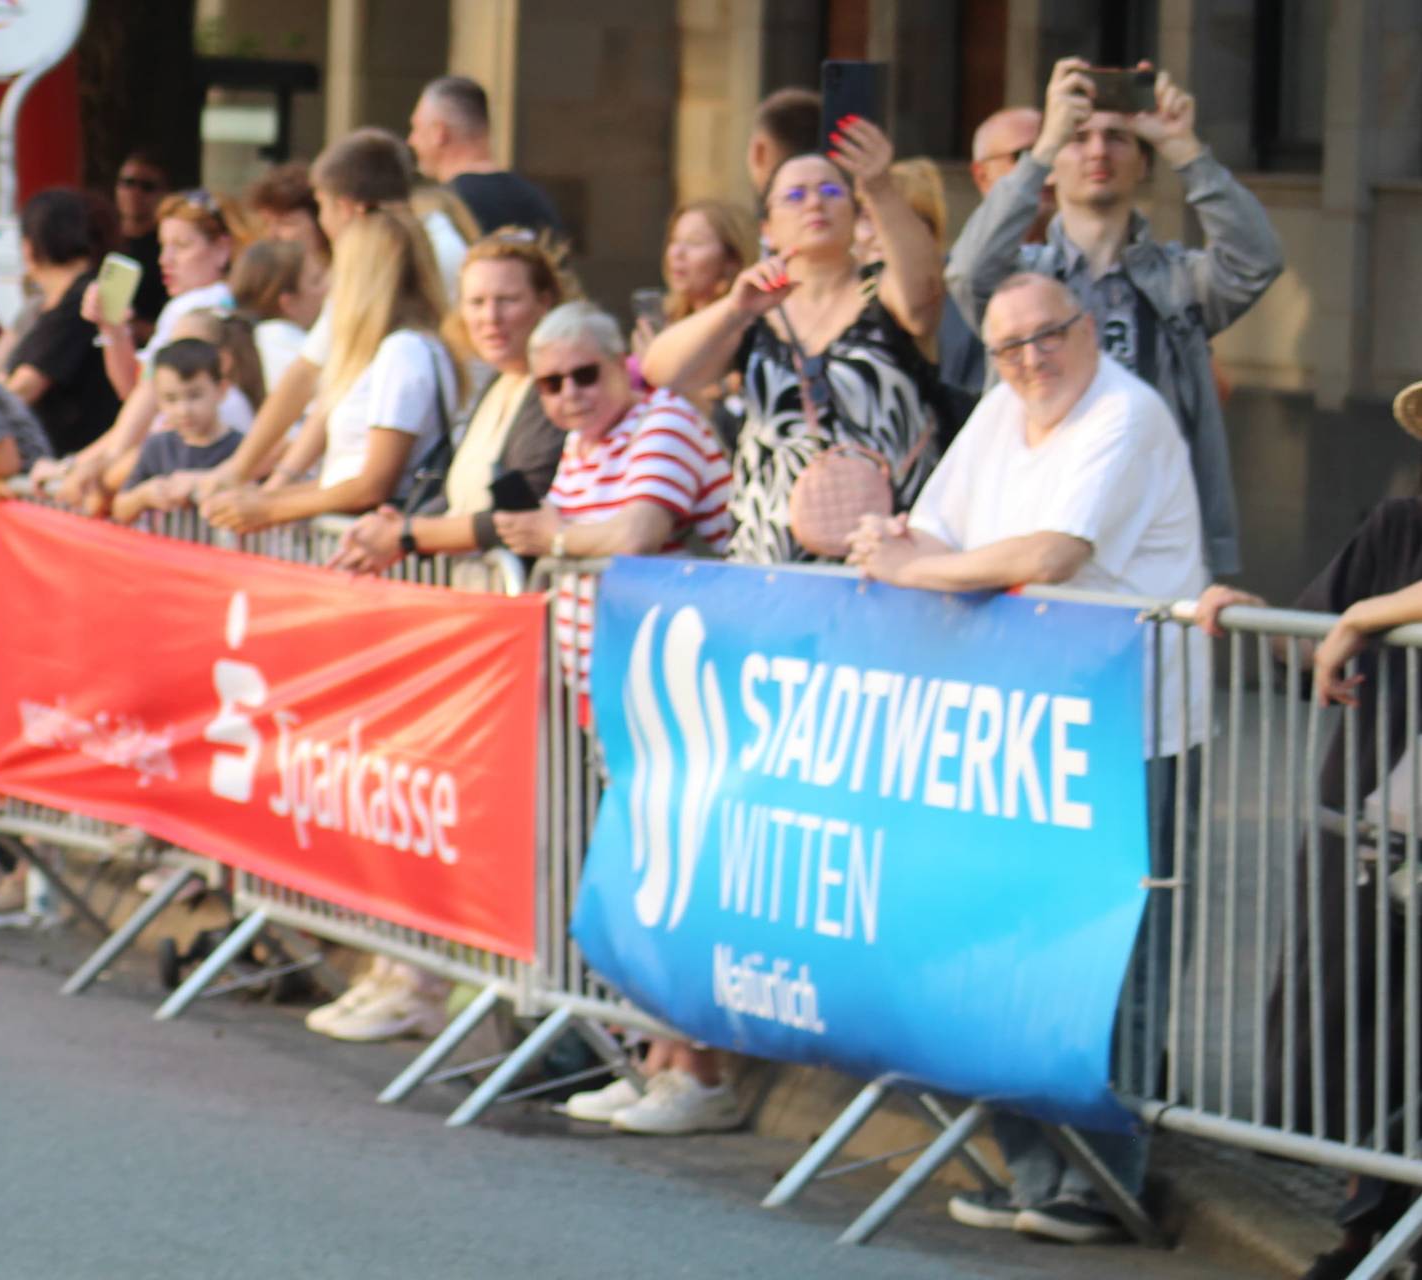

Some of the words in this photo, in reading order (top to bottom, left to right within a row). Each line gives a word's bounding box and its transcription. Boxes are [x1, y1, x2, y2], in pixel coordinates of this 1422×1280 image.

[269, 709, 461, 864] Sparkasse
[739, 652, 1094, 830] STADTWERKE
[718, 799, 885, 945] WITTEN
